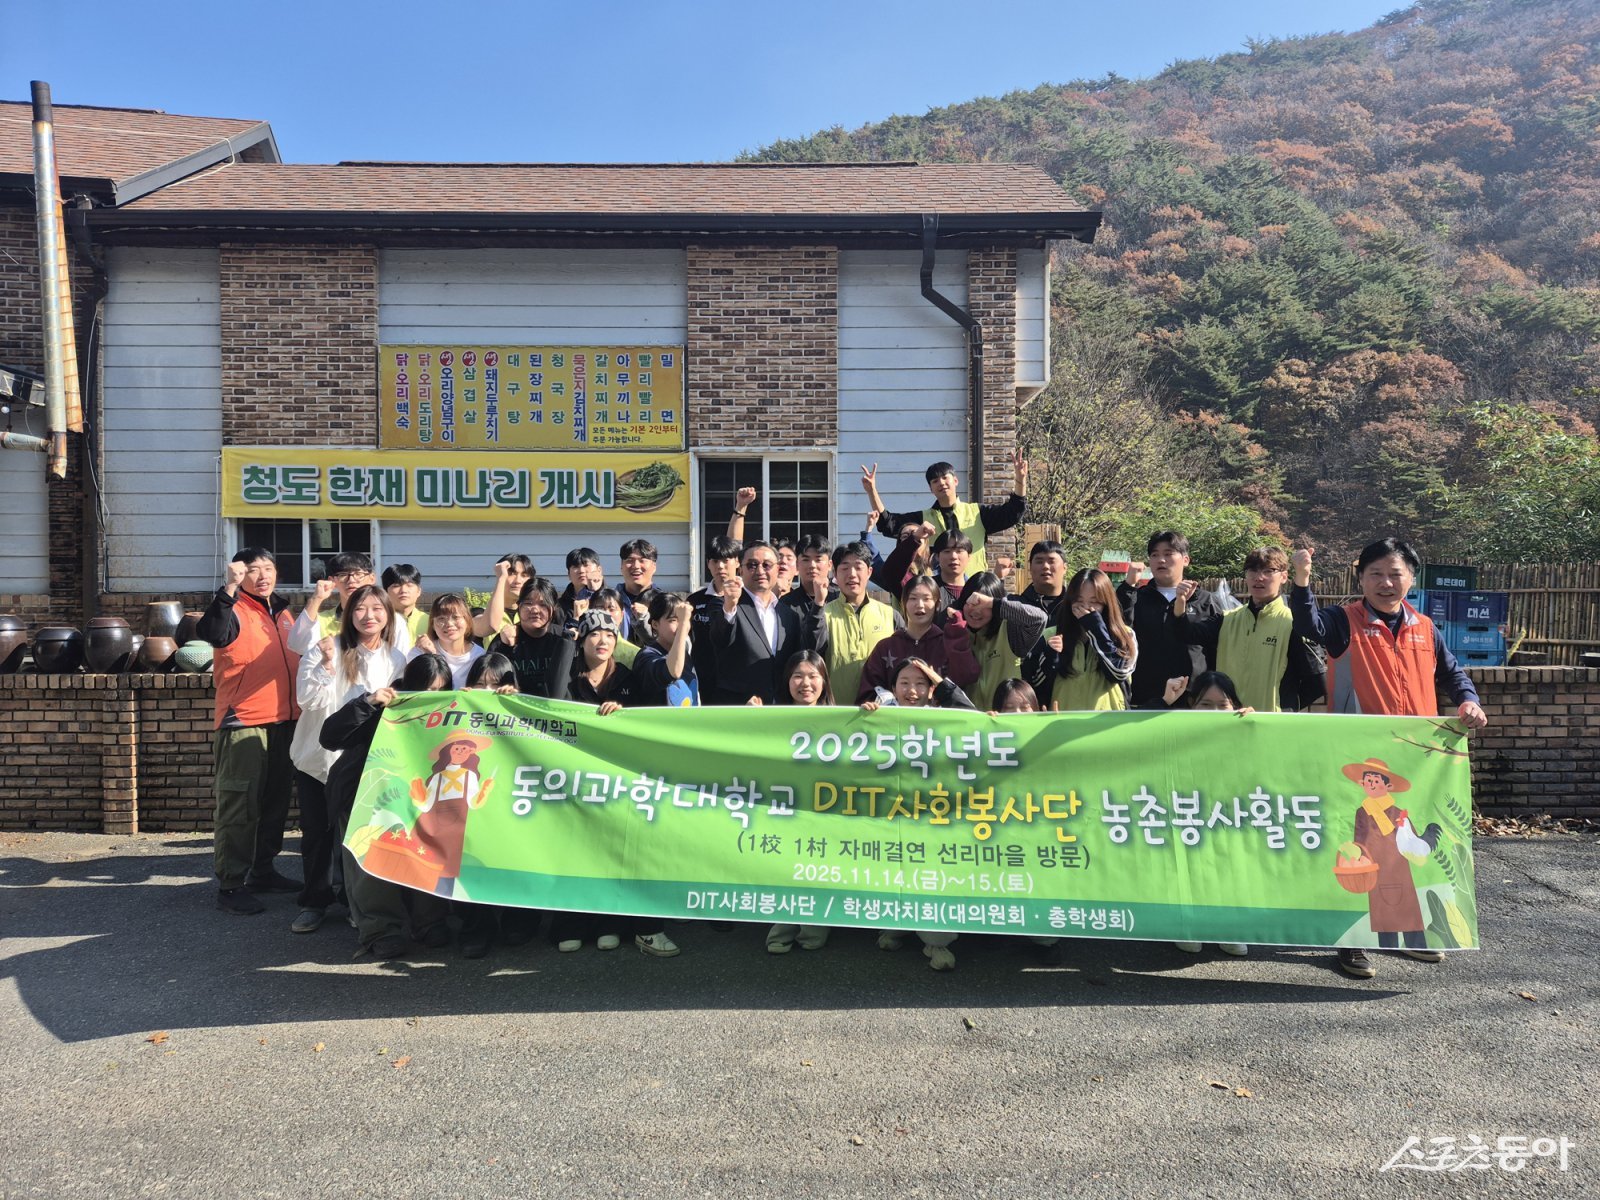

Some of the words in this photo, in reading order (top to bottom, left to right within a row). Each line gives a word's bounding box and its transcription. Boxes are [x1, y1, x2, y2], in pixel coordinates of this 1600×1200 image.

[630, 425, 646, 434] 기본
[649, 425, 678, 434] 2인부터
[242, 465, 318, 503] 청도
[329, 466, 405, 504] 한재
[416, 468, 529, 506] 미나리
[540, 470, 613, 505] 개시
[1467, 607, 1490, 618] 대선
[426, 702, 467, 729] DIT
[469, 712, 578, 738] 동의과학대학교
[790, 725, 1019, 780] 2025학년도
[511, 765, 795, 829] 동의과학대학교
[1101, 784, 1323, 850] 농촌봉사활동
[737, 831, 782, 854] (1校
[794, 836, 828, 859] 1村
[839, 838, 926, 864] 자매결연
[937, 843, 1026, 868] 선리마을
[1036, 845, 1092, 870] 방문)
[686, 891, 816, 916] DIT사회봉사단
[843, 897, 1026, 927] 학생자치회(대의원회
[1047, 905, 1136, 933] 총학생회)
